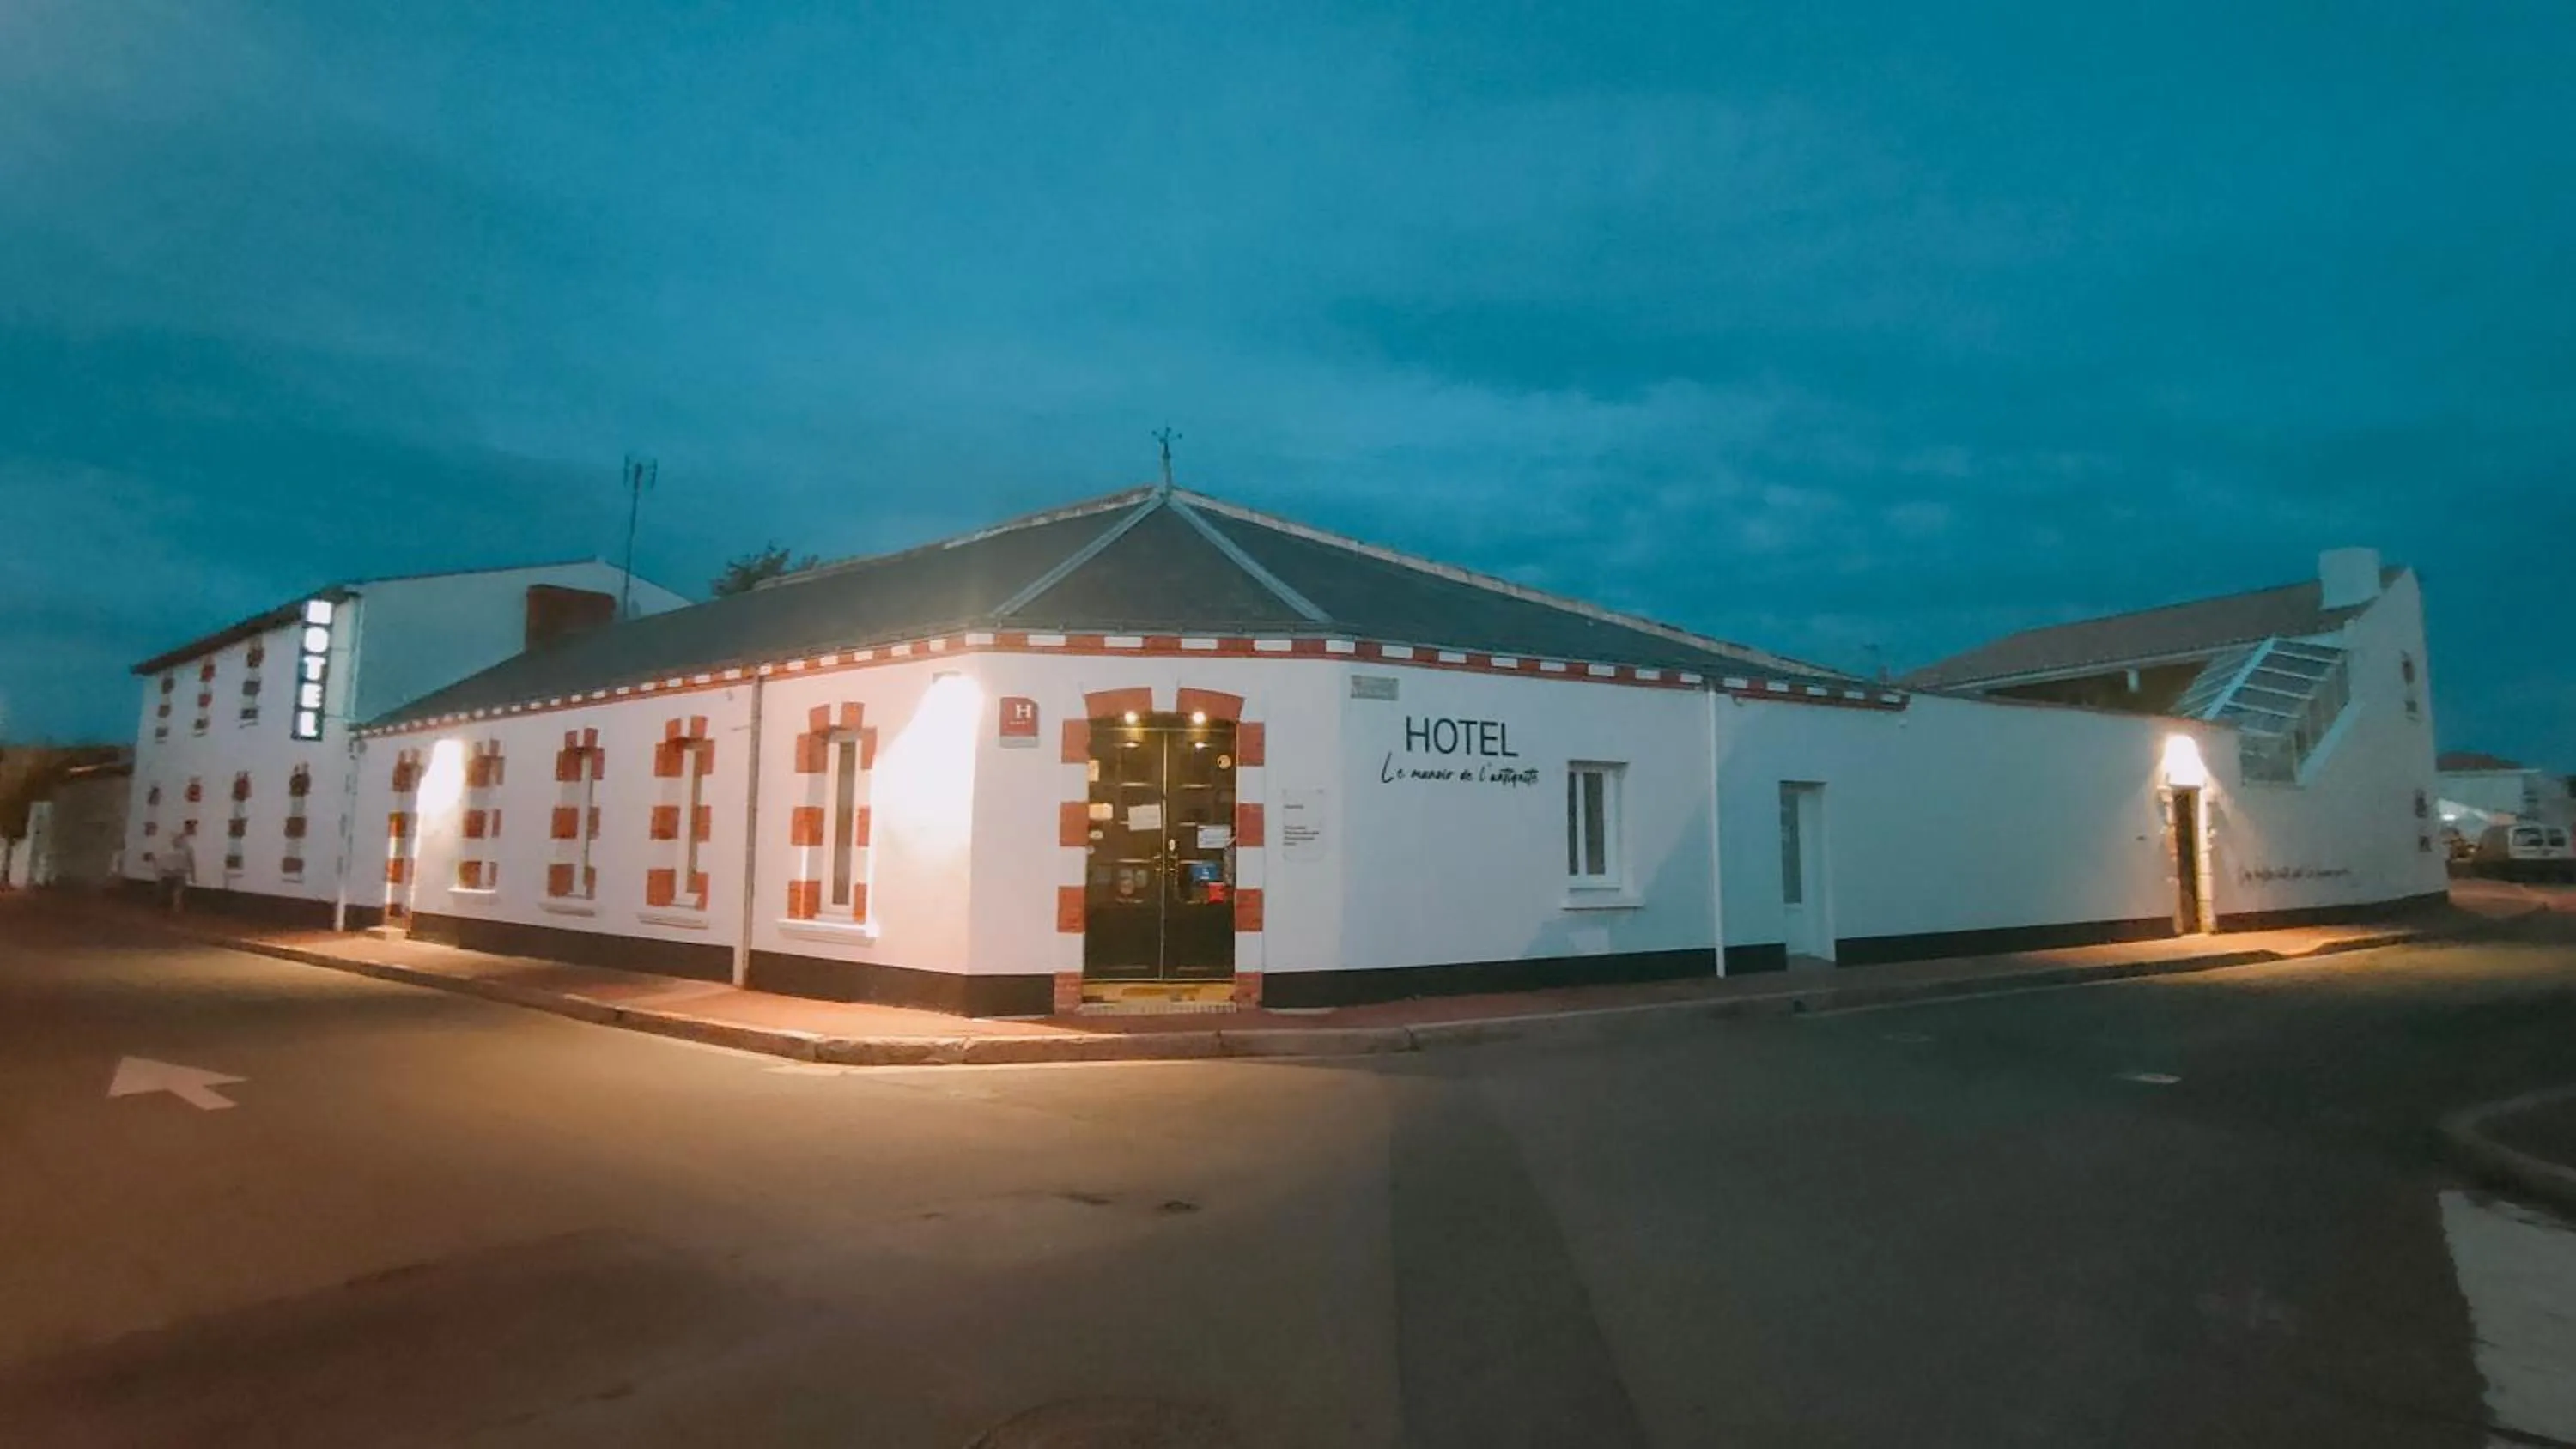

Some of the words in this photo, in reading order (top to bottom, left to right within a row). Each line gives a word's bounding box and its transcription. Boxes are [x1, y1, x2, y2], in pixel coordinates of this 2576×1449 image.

[1016, 704, 1031, 718] H
[1406, 716, 1519, 757] HOTEL
[1382, 752, 1406, 784] Le
[1460, 769, 1474, 781] de
